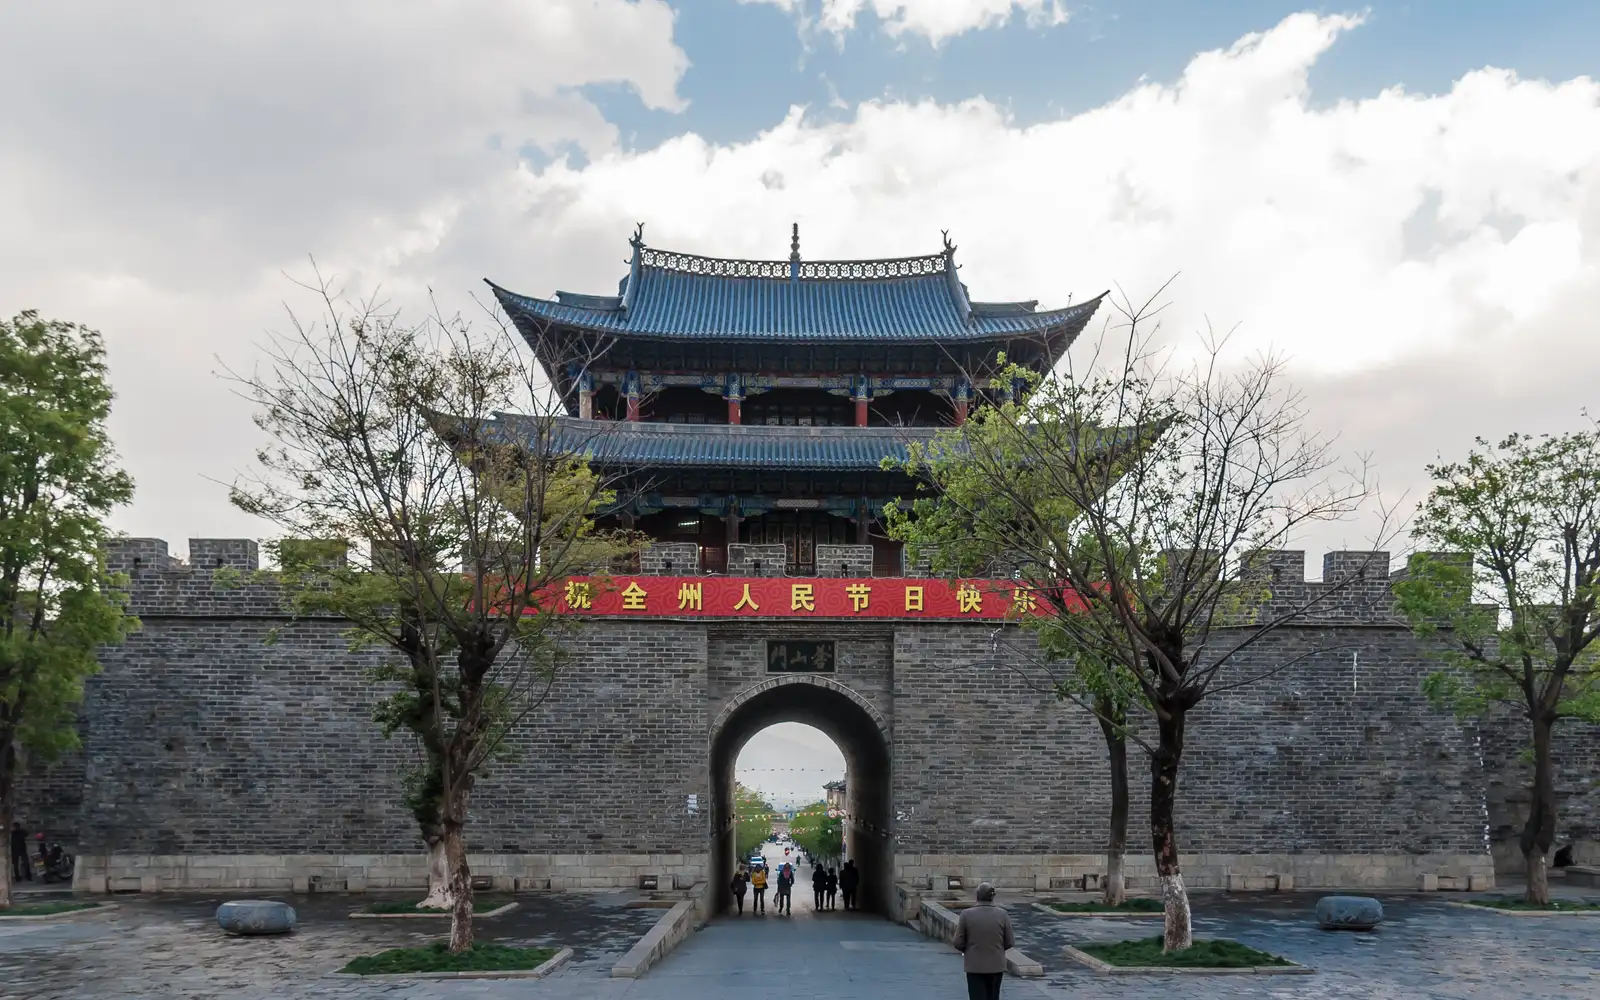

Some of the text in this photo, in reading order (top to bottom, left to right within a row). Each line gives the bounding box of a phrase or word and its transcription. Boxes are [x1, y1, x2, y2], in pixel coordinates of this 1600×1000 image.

[565, 581, 1036, 612] 祝全州人民节日快乐
